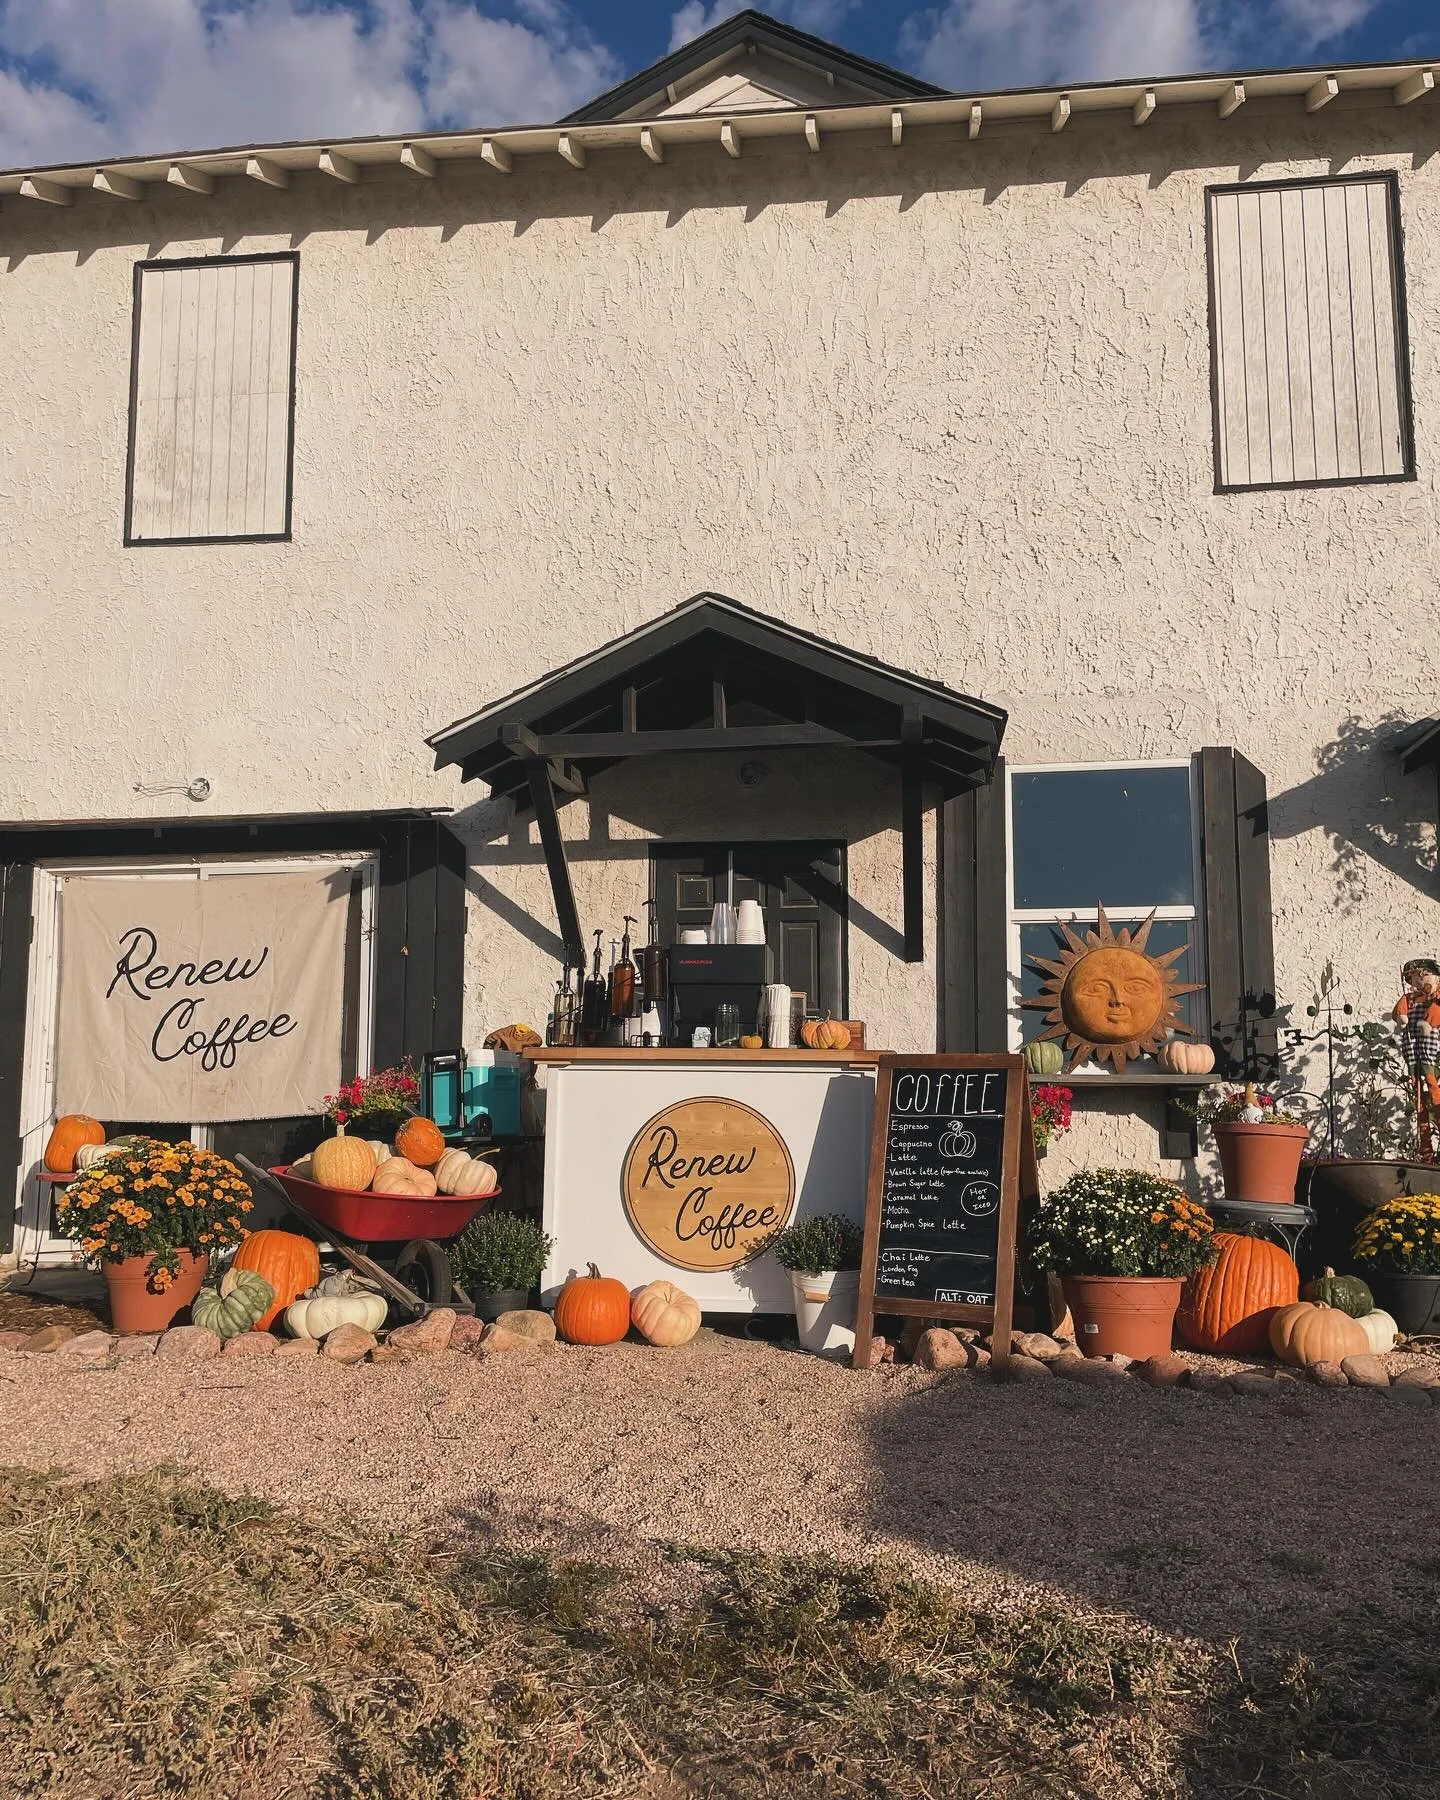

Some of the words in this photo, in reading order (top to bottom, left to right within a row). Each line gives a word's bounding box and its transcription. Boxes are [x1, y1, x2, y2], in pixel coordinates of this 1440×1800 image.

[106, 927, 269, 1000] Renew
[151, 998, 298, 1072] Coffee
[642, 1125, 756, 1189] Renew
[886, 1192, 916, 1202] Caramel
[676, 1186, 779, 1250] Coffee
[885, 1219, 915, 1231] Pumpkin
[918, 1219, 935, 1230] Spice
[882, 1252, 906, 1262] Chai
[882, 1265, 905, 1274] London
[907, 1264, 919, 1277] Fog
[880, 1274, 900, 1285] Green
[940, 1292, 961, 1302] ALT:
[966, 1294, 989, 1305] OAT
